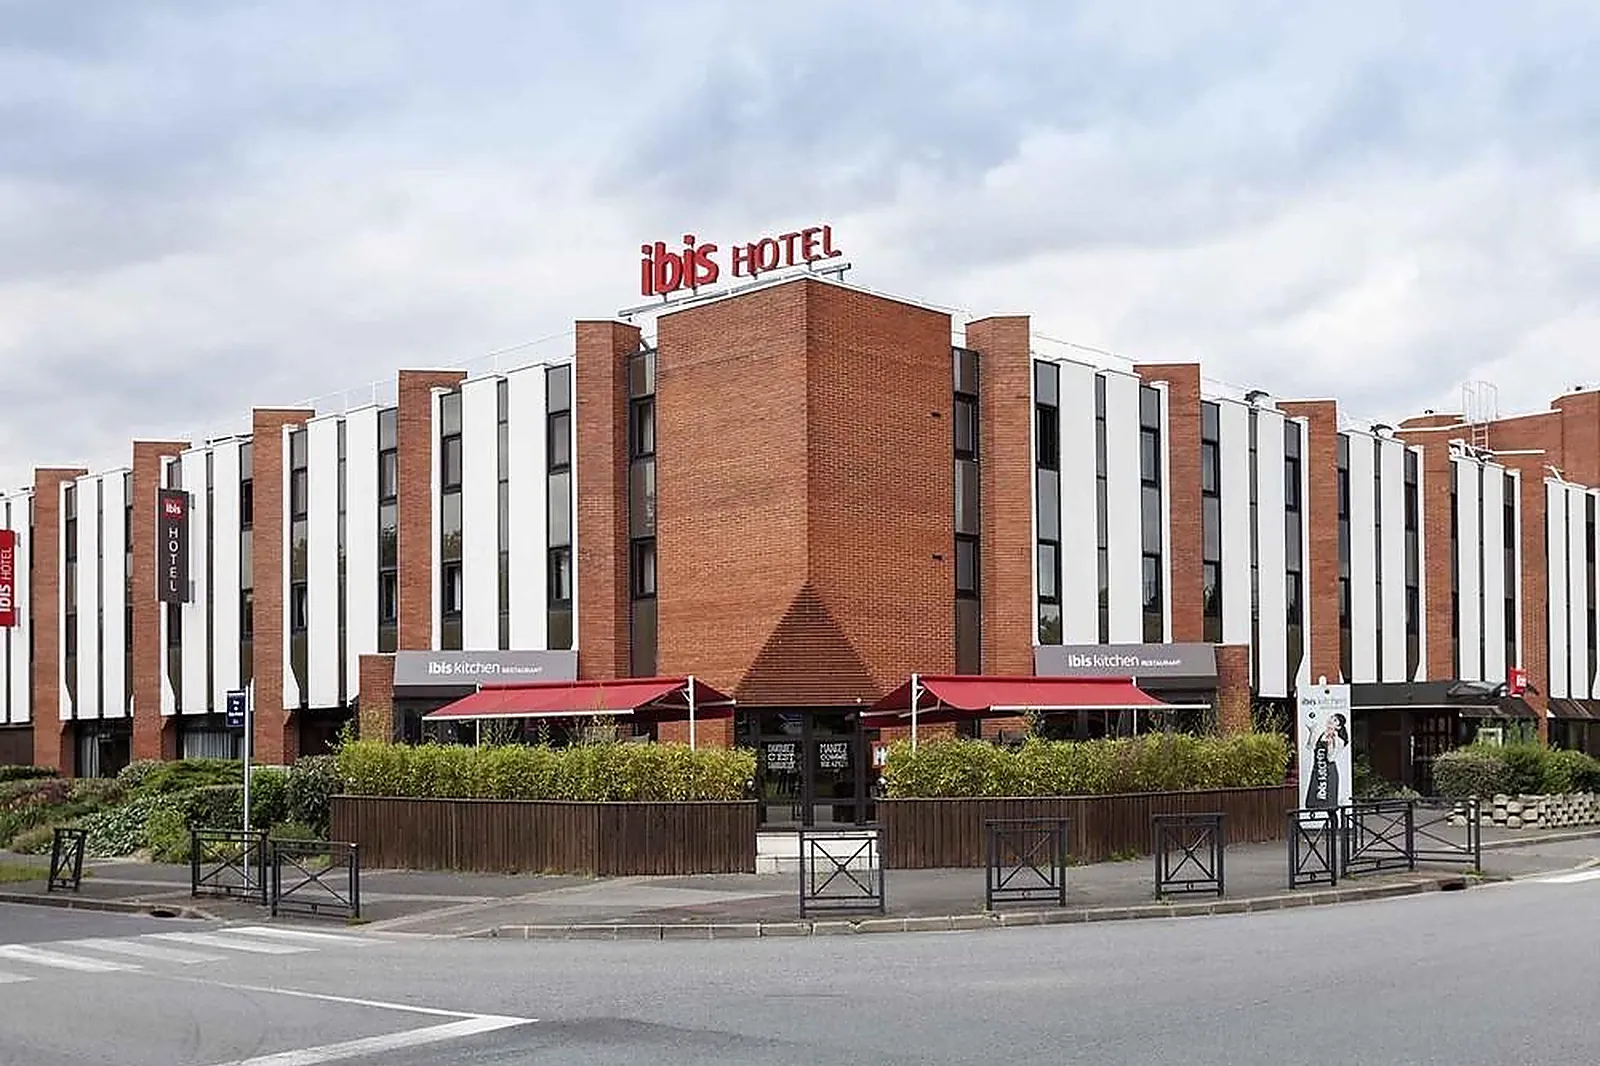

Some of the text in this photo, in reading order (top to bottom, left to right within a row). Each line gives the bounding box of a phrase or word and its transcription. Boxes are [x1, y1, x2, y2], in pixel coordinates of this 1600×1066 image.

[641, 225, 842, 296] ibis HOTEL
[165, 502, 181, 514] ibis
[1, 547, 12, 581] HOTEL
[168, 526, 179, 592] HOTEL
[429, 661, 452, 674] ibis
[454, 661, 500, 674] kitchen
[1068, 654, 1092, 667] ibis
[1094, 653, 1139, 667] kitchen
